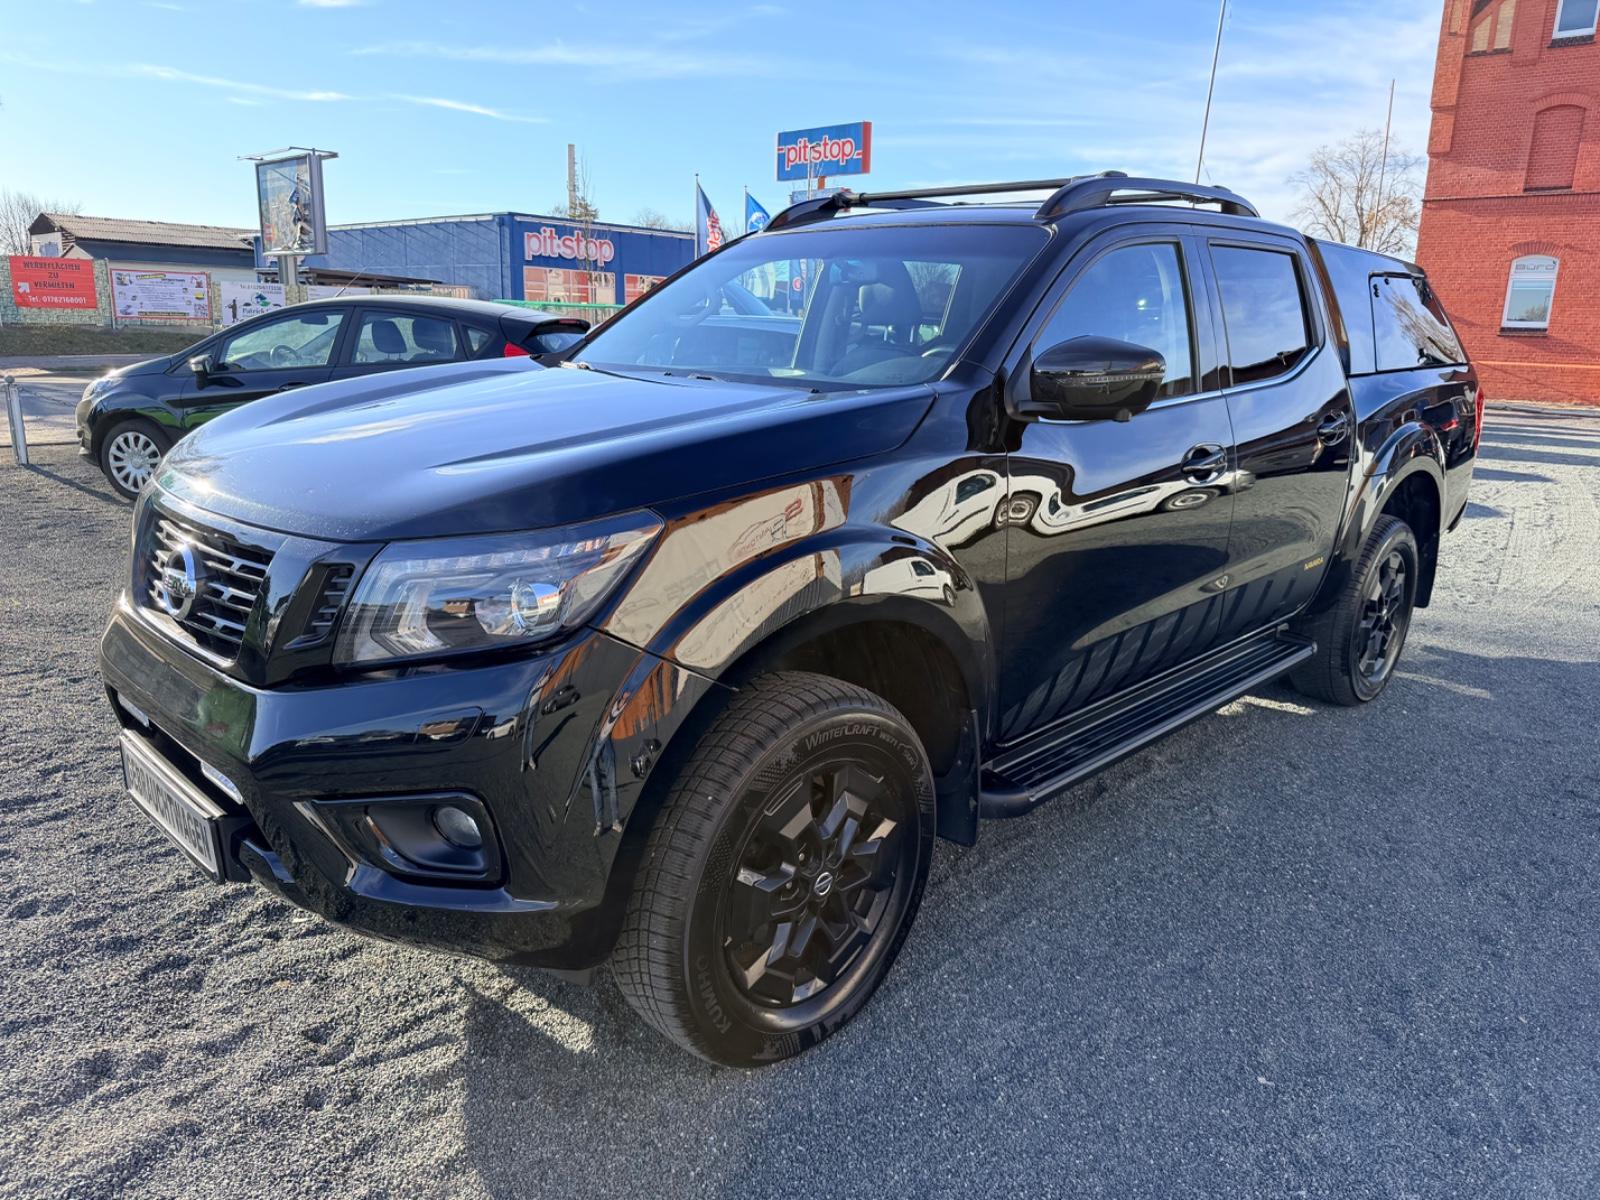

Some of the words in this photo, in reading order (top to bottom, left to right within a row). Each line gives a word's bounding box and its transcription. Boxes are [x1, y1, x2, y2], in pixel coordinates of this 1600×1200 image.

[47, 271, 59, 279] ZU
[33, 280, 75, 289] VERMIETEN
[696, 955, 733, 1034] KUMHO
